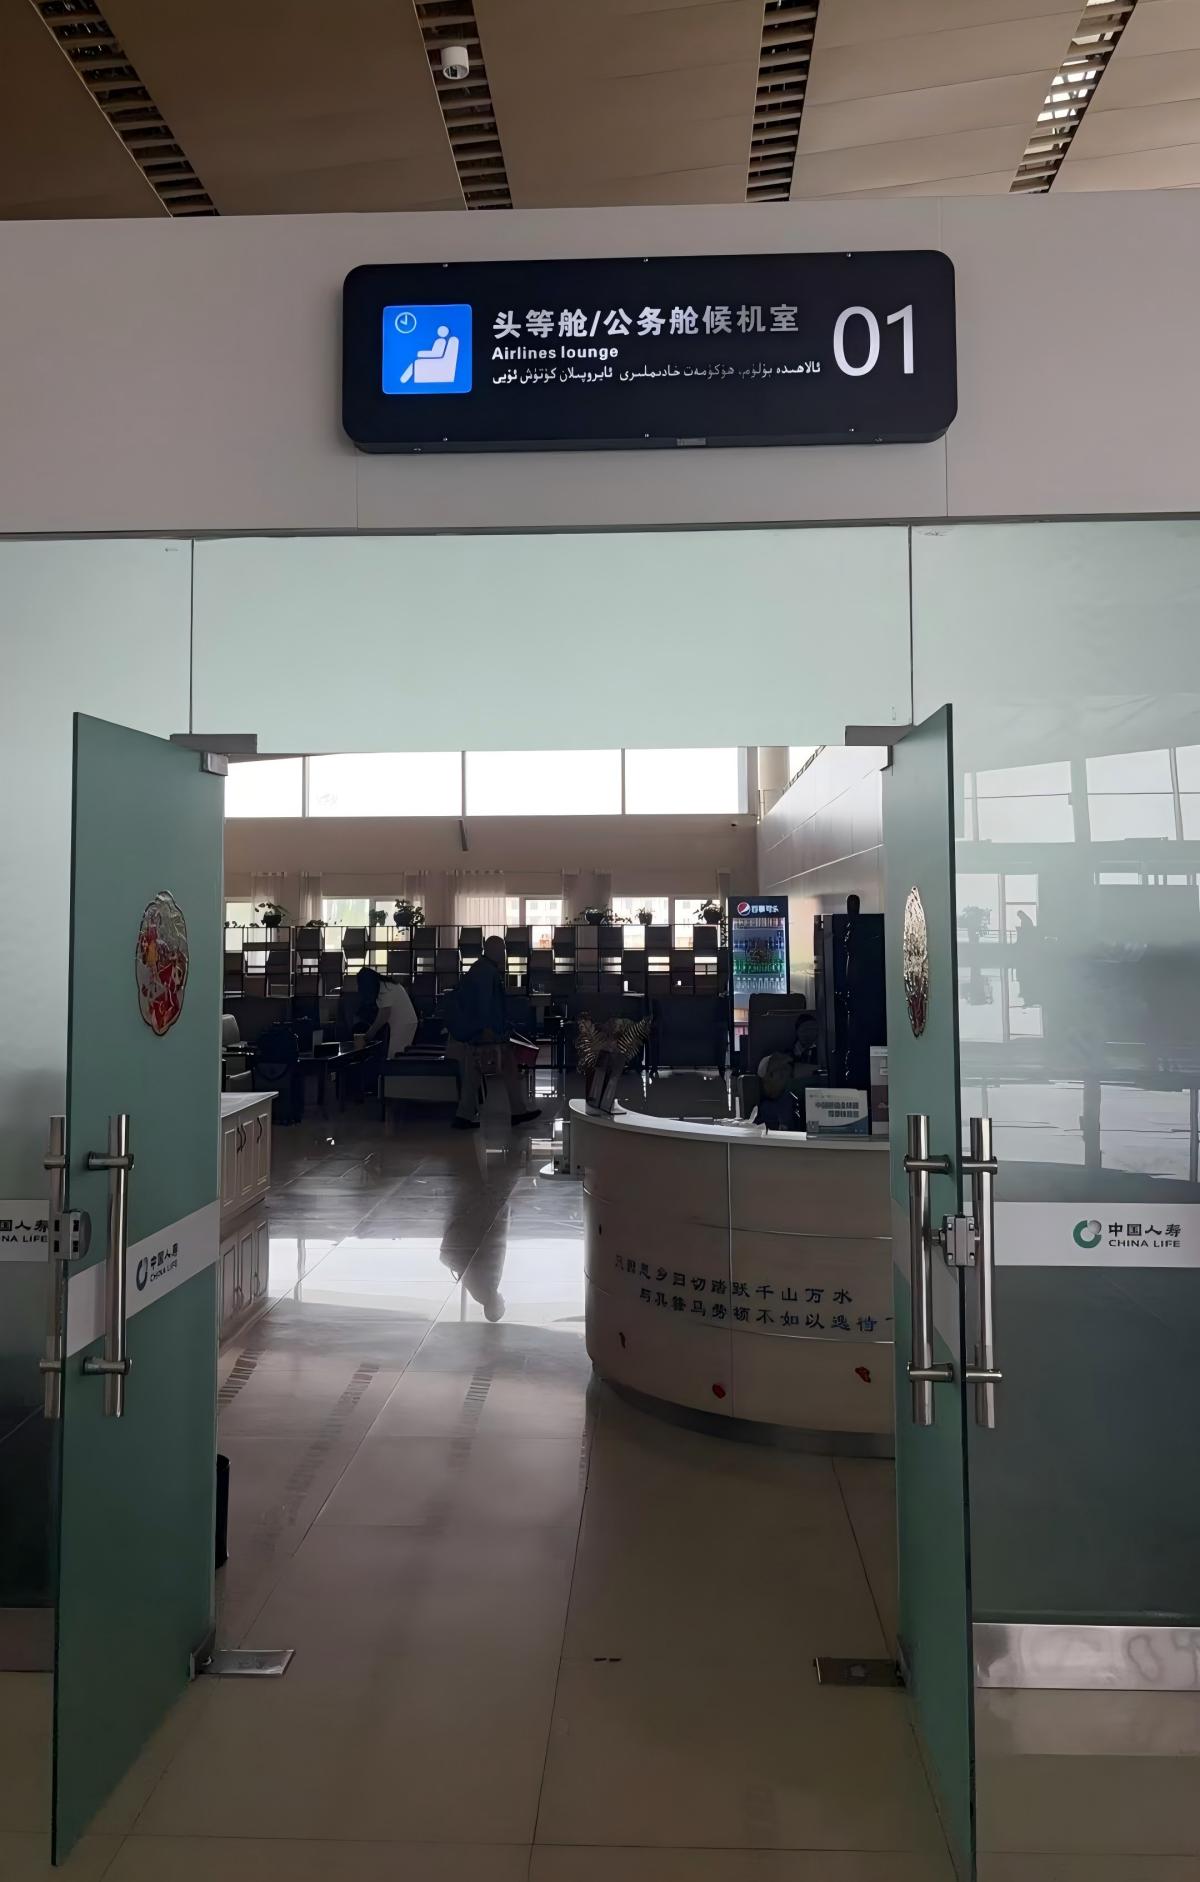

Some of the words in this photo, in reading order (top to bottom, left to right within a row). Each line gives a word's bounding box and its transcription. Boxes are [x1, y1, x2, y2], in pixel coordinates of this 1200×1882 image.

[492, 303, 799, 339] 头等舱/公务舱候机室
[833, 304, 914, 377] 01
[491, 346, 557, 361] Airlines
[561, 345, 619, 361] lounge
[1108, 1221, 1182, 1237] 中国人寿
[1108, 1239, 1149, 1248] CHINA
[1153, 1239, 1181, 1248] LIFE
